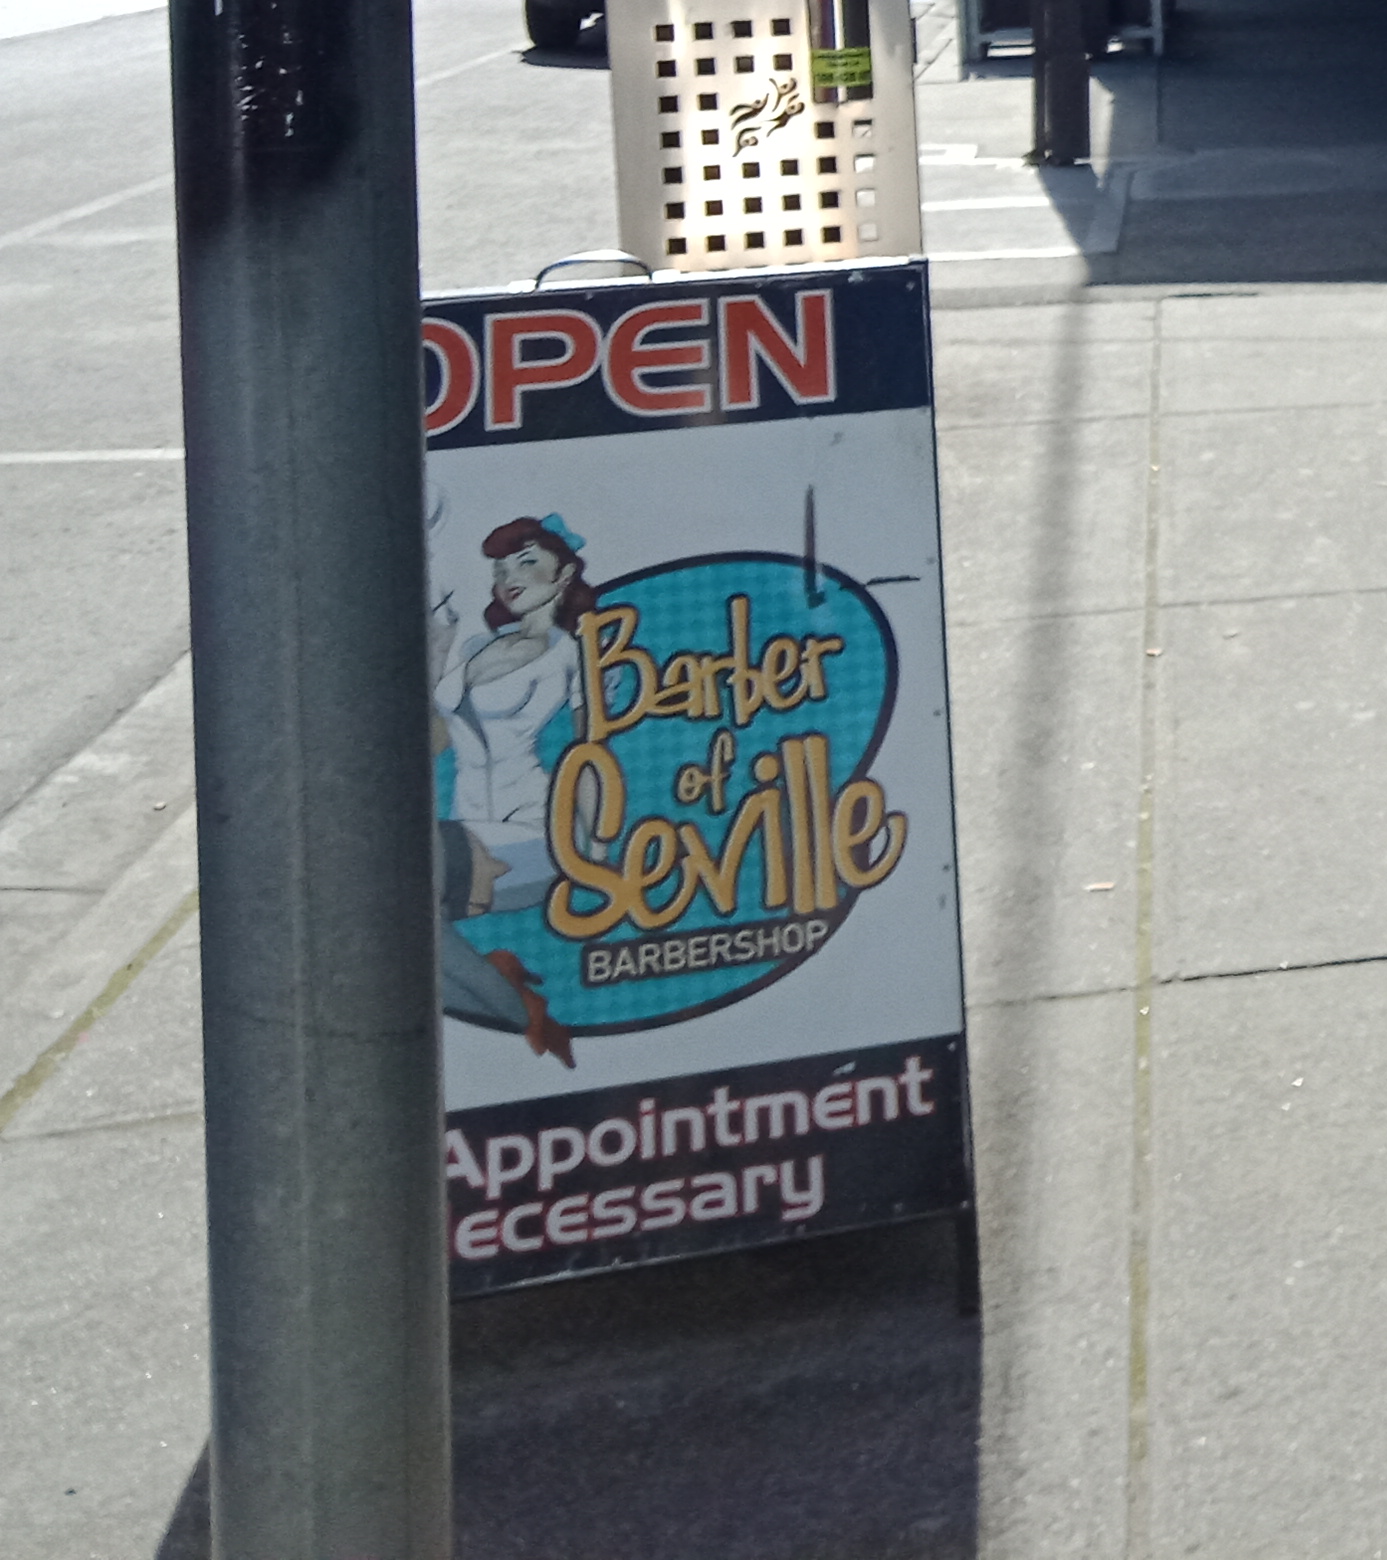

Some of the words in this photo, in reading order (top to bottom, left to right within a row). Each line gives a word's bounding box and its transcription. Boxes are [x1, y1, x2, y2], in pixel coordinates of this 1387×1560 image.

[421, 288, 837, 437] OPEN
[576, 594, 844, 742] Barber
[546, 736, 908, 939] Seville
[676, 729, 735, 813] of
[586, 919, 830, 983] BARBERSHOP
[444, 1055, 935, 1200] Appointment
[450, 1155, 825, 1260] ecessary
